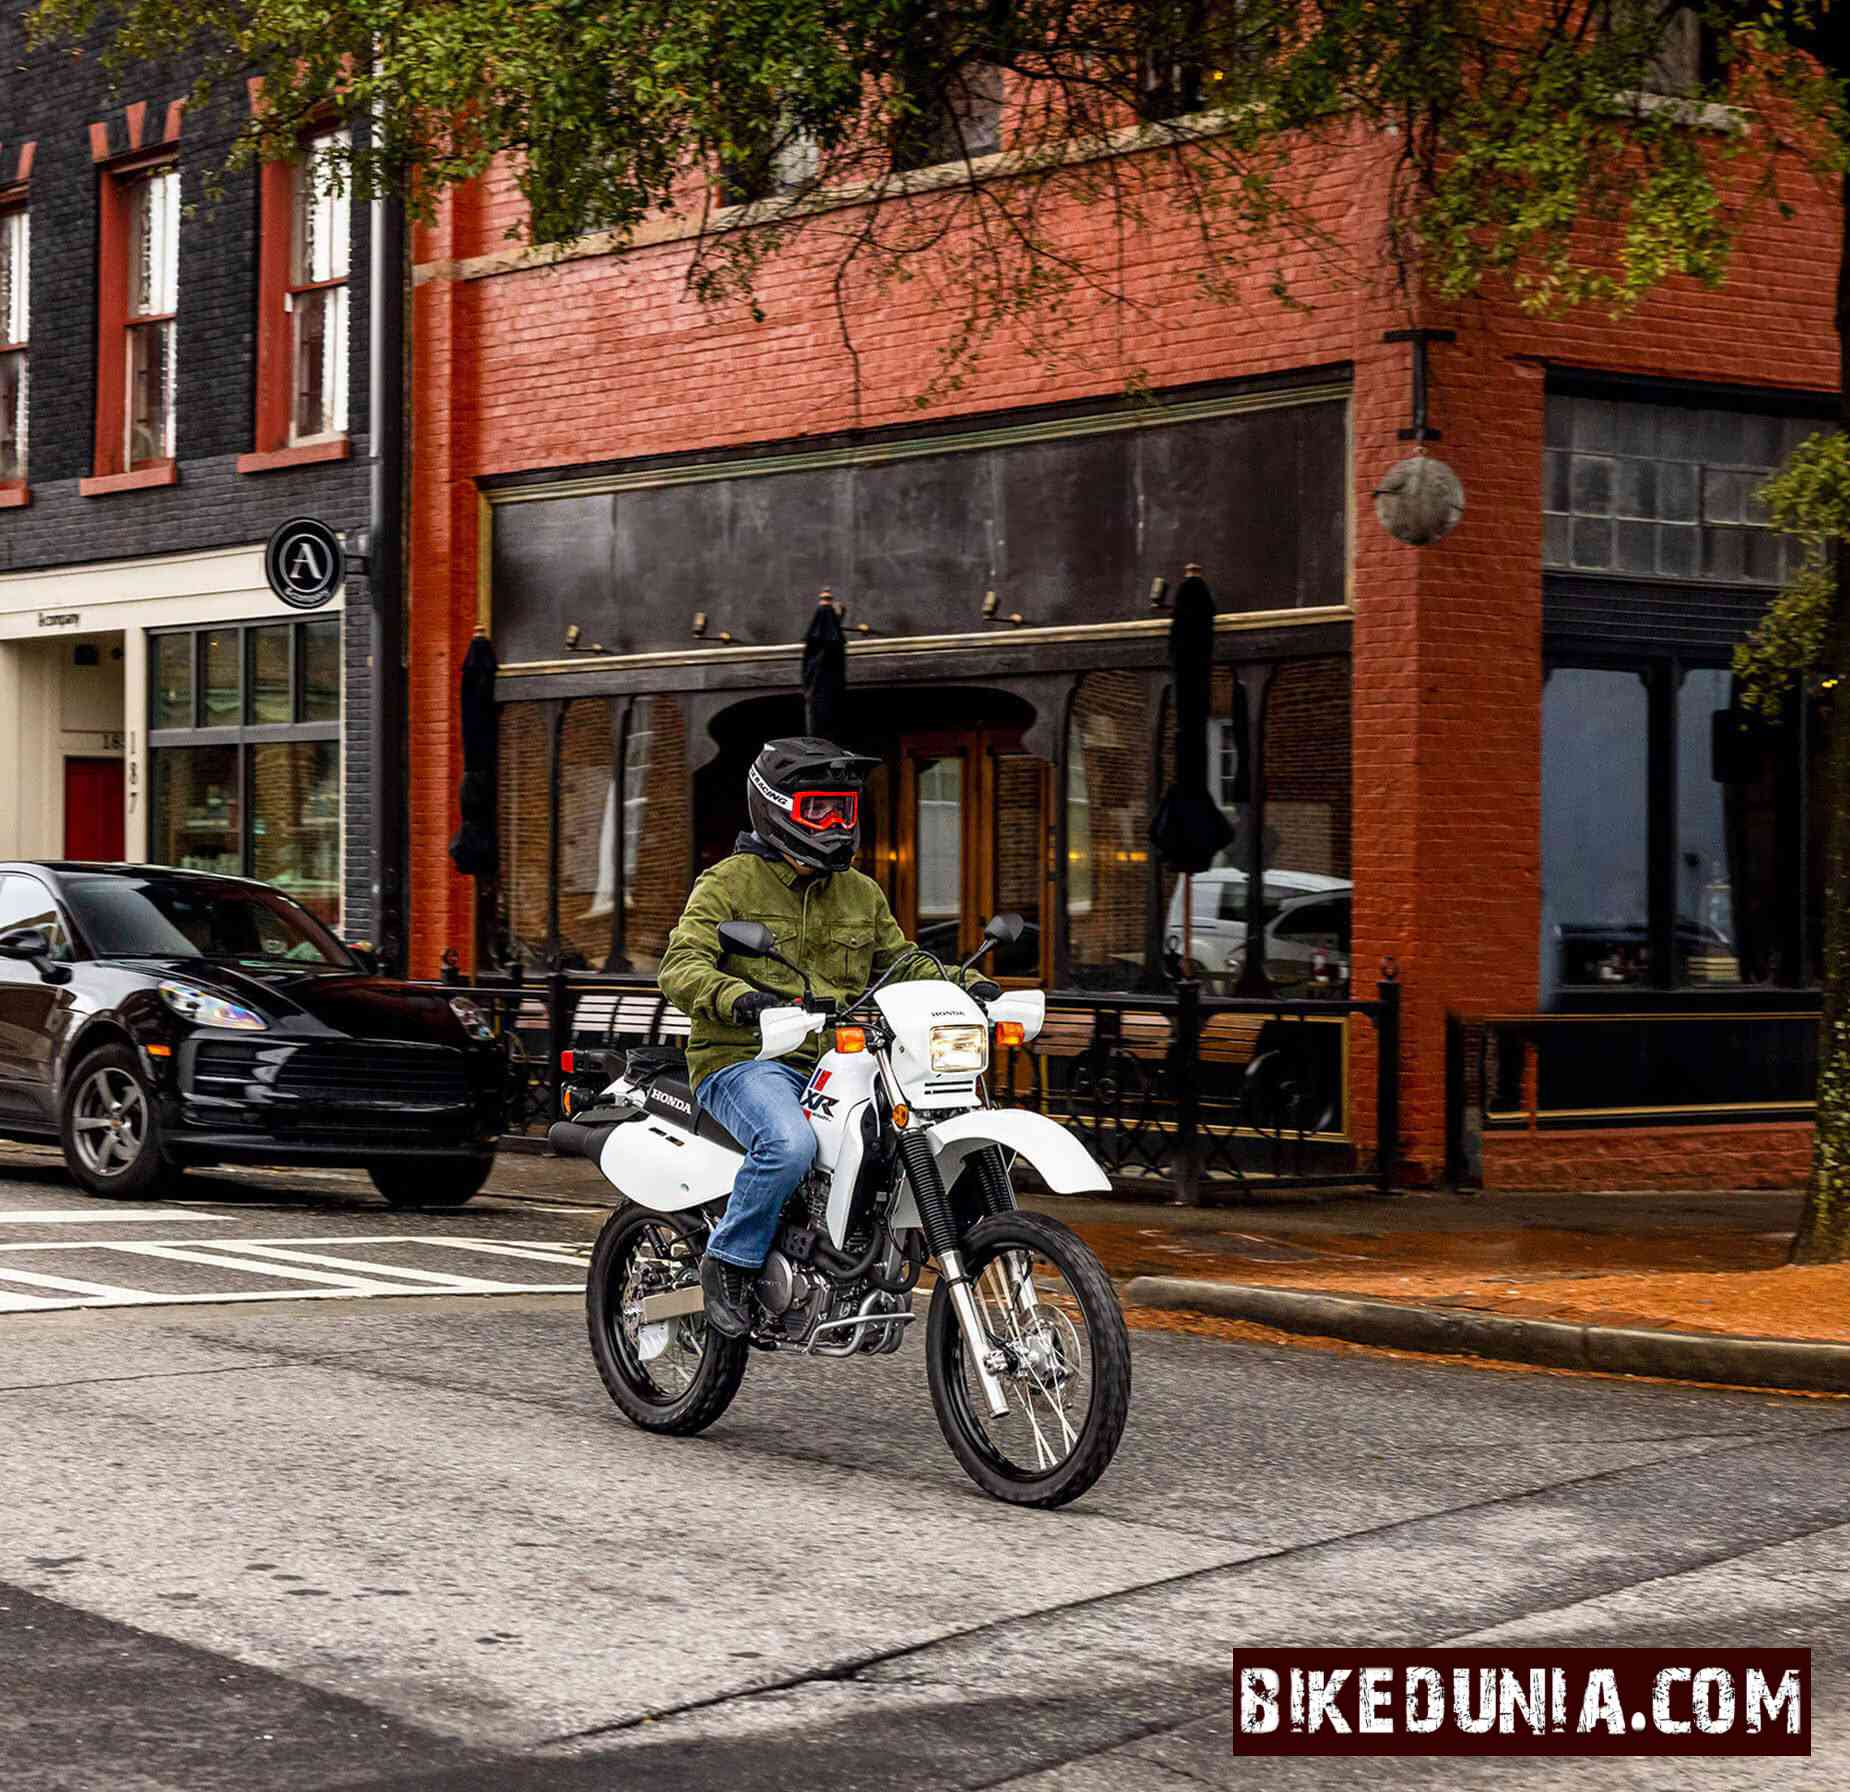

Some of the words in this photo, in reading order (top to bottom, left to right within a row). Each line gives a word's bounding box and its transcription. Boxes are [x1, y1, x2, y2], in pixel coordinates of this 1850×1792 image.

[289, 543, 322, 579] A
[651, 1088, 692, 1115] HONDA
[800, 1089, 840, 1118] XR
